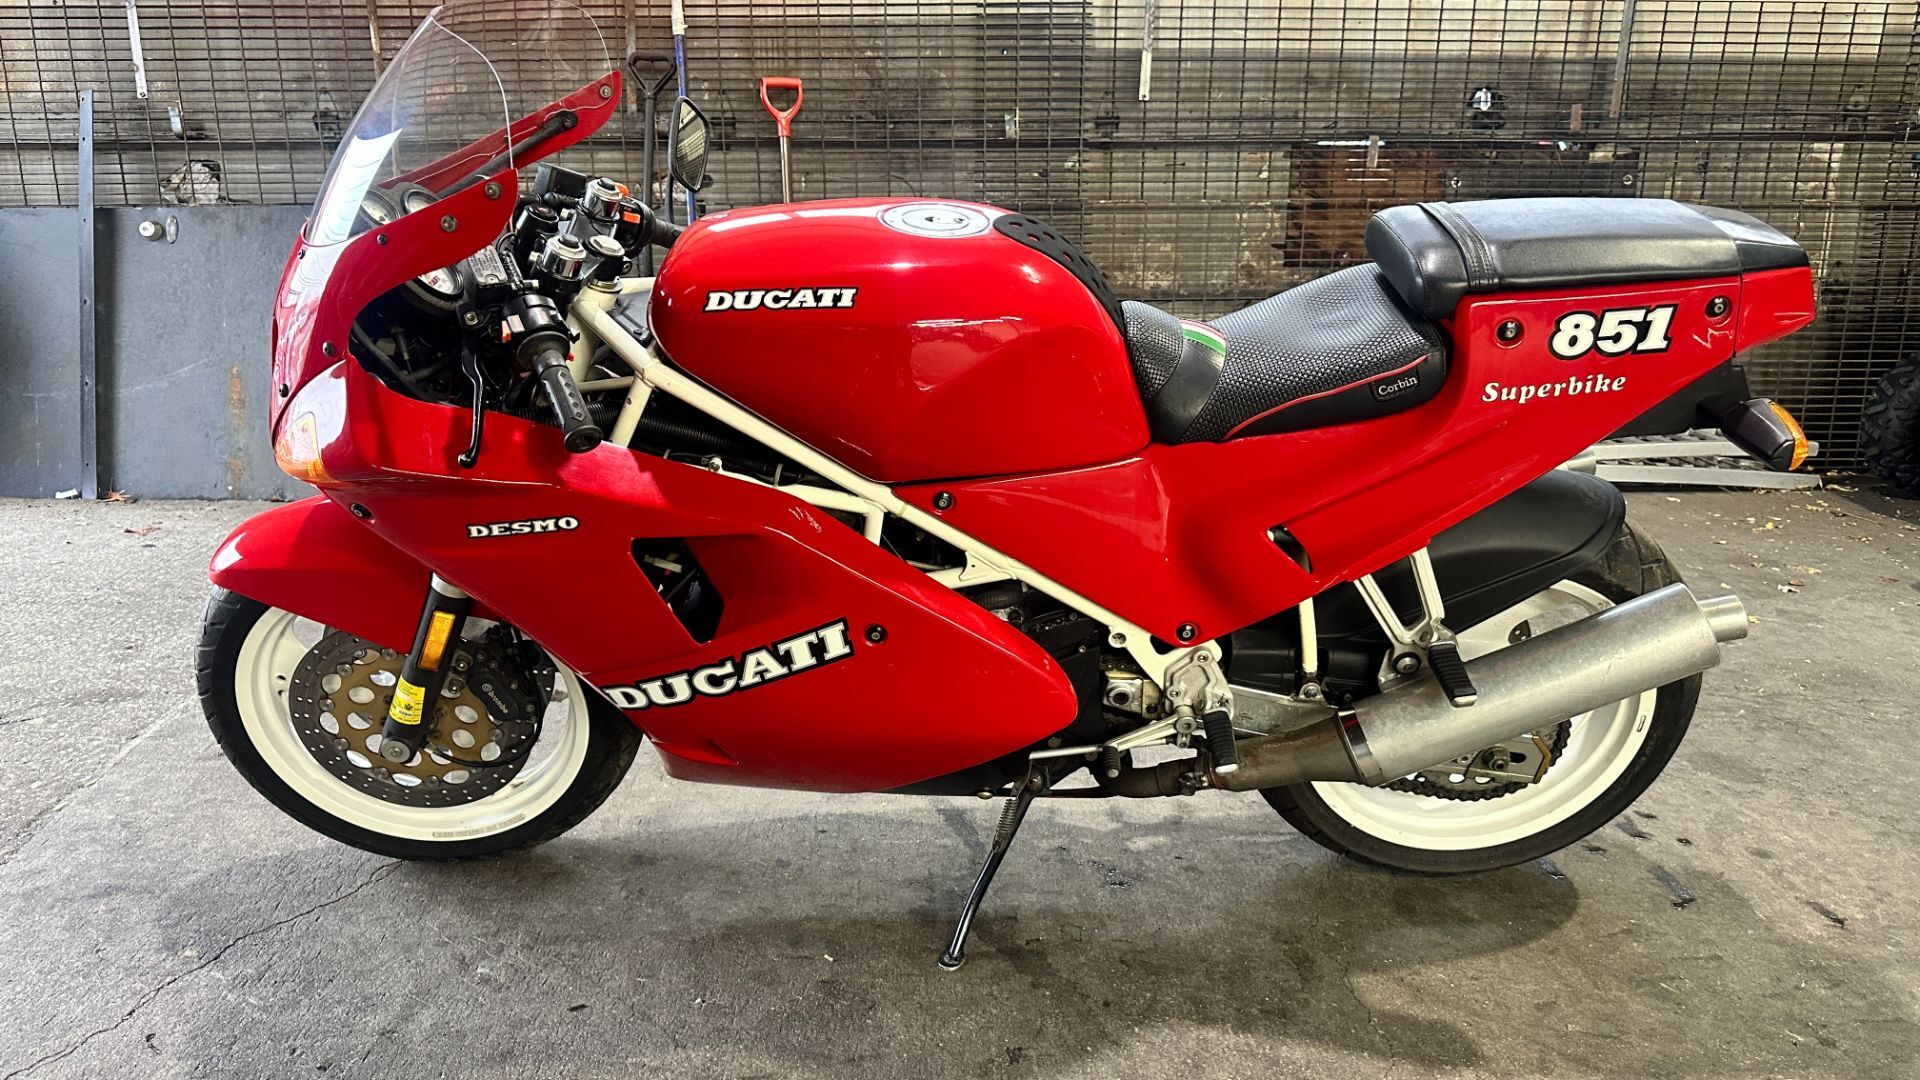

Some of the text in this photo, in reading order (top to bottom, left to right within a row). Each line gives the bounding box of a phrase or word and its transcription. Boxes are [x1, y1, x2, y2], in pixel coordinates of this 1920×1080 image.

[704, 287, 857, 312] DUCATI
[1550, 305, 1677, 359] 851
[1378, 377, 1418, 395] Corbin
[1481, 373, 1627, 404] Superbike
[467, 516, 579, 538] DESMO
[601, 619, 853, 709] DUCATI
